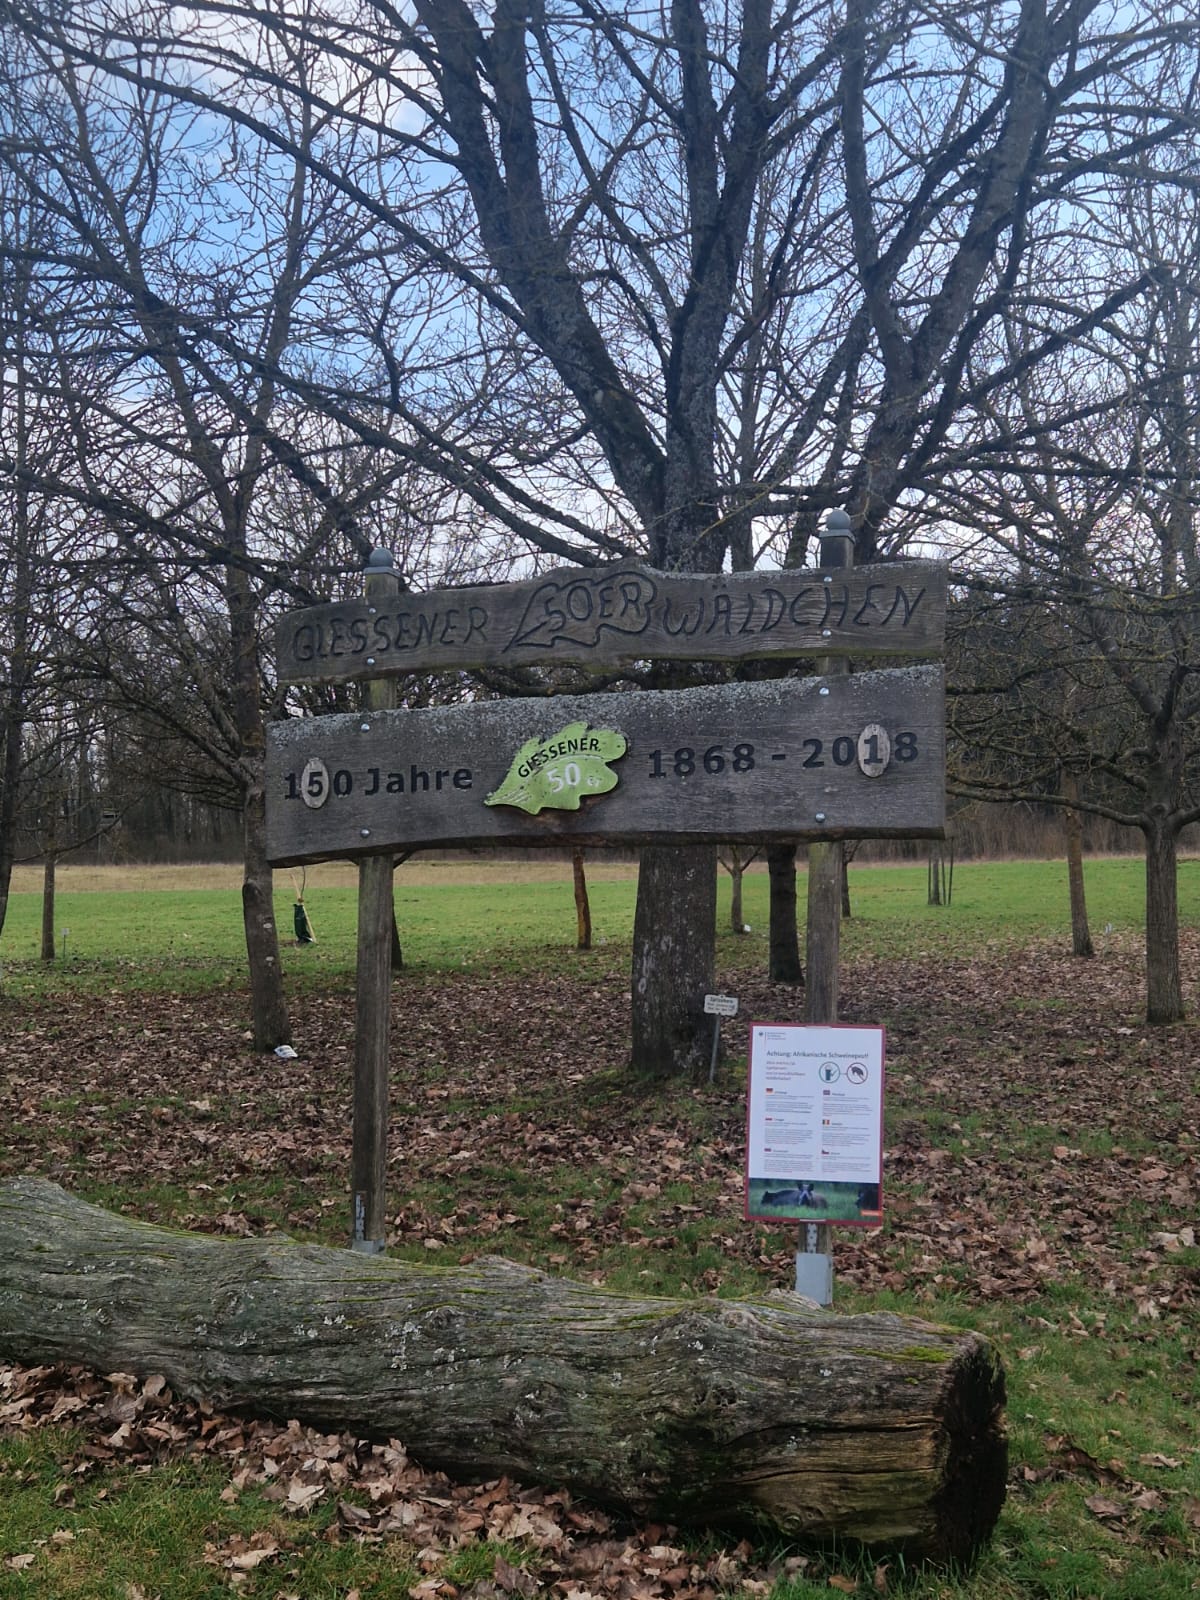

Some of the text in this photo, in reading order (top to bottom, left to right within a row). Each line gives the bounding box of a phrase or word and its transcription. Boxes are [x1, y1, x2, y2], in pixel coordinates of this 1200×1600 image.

[544, 582, 643, 632] 50ER
[662, 583, 927, 637] WÄLDCHEN
[648, 731, 920, 779] 1868 - 2018
[284, 764, 474, 800] 150 Jahre
[792, 1051, 827, 1059] Afrikanische
